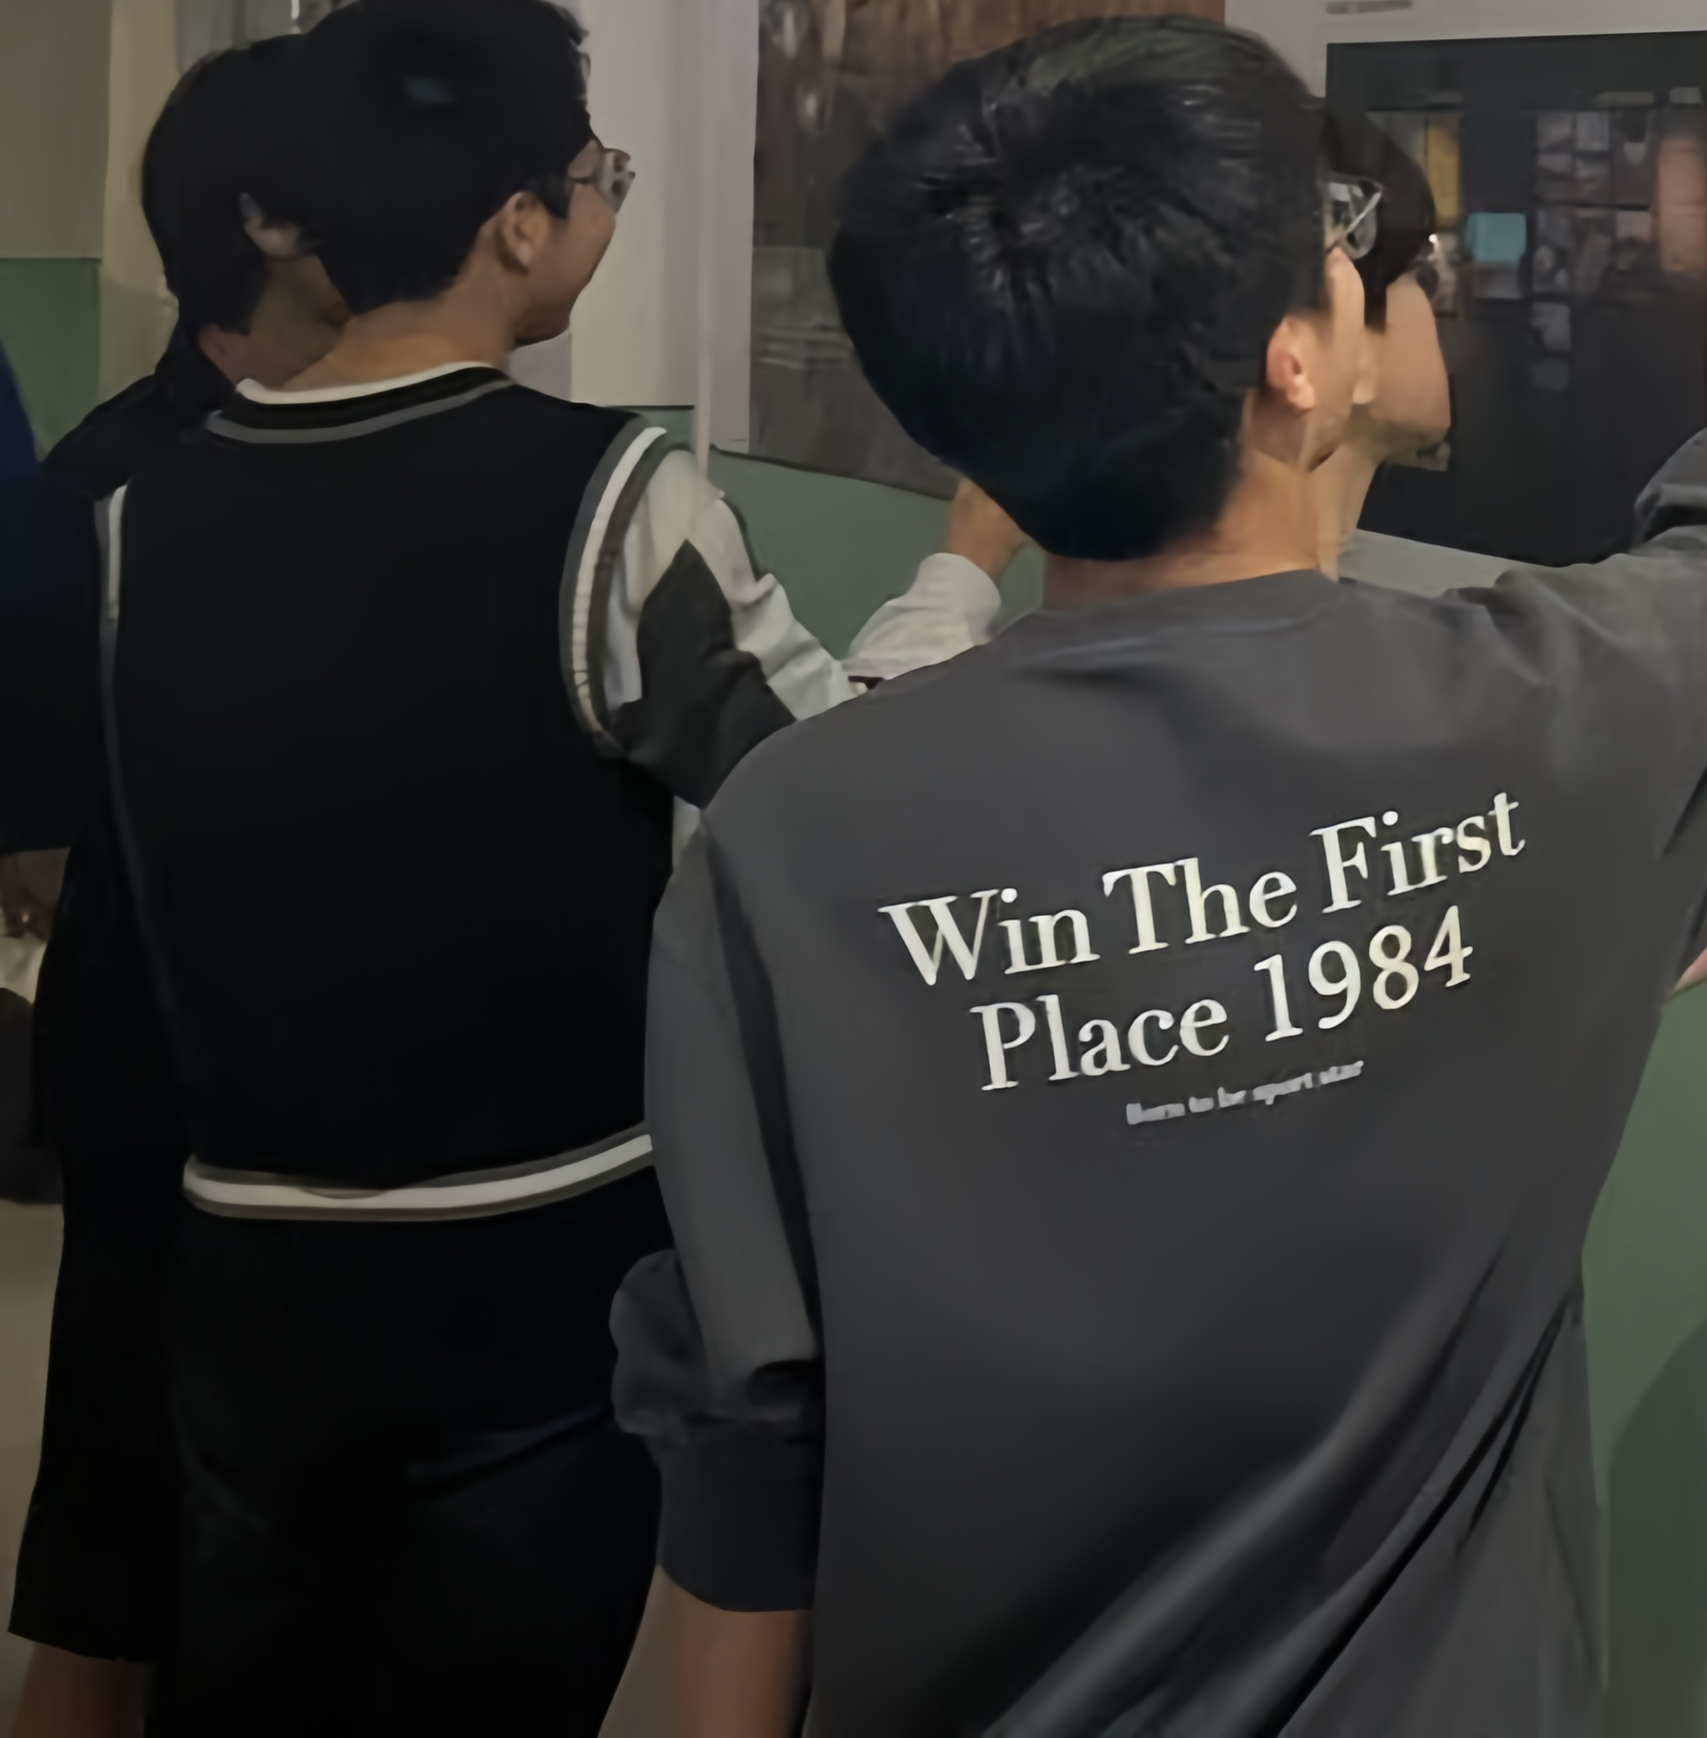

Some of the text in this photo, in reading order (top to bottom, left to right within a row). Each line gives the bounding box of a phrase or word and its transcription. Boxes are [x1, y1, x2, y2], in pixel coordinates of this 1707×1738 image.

[878, 792, 1526, 987] Win The First
[969, 906, 1474, 1092] Place 1984
